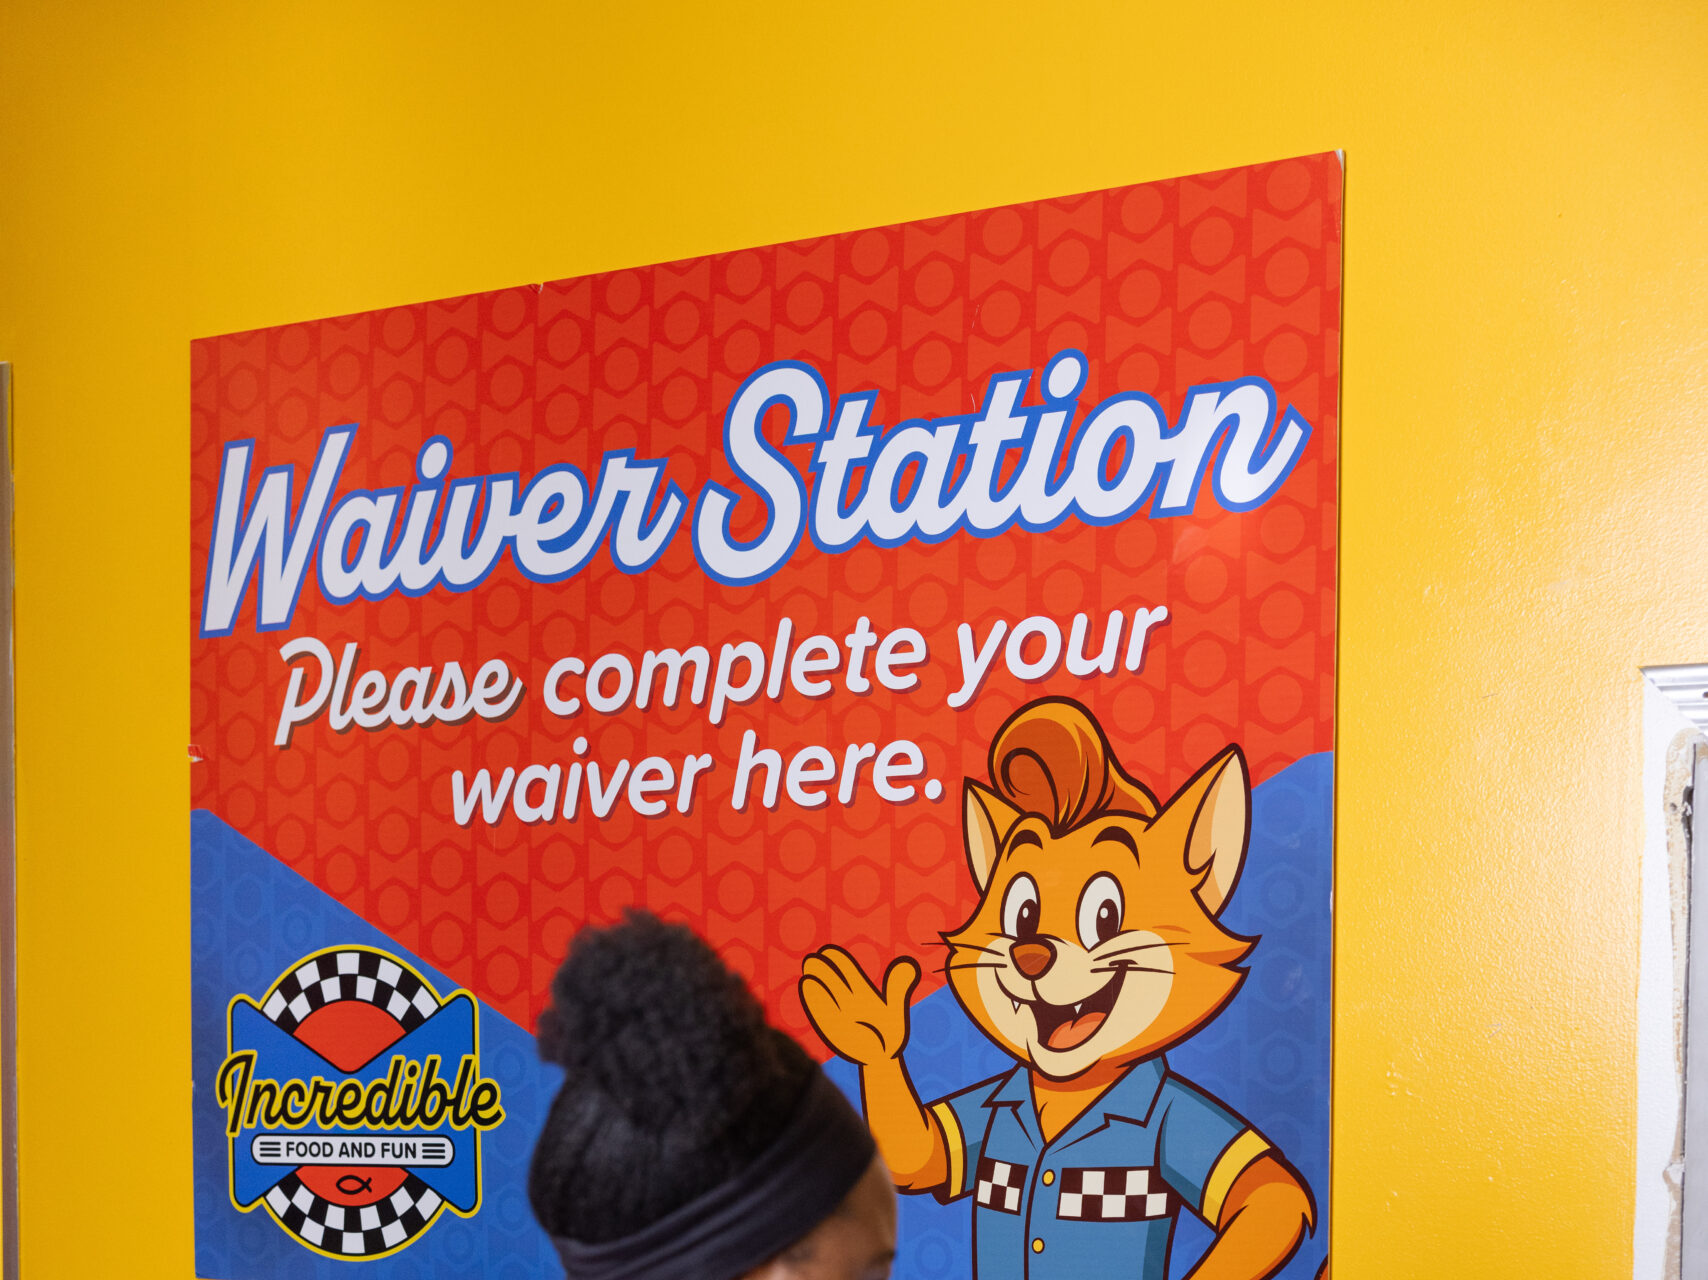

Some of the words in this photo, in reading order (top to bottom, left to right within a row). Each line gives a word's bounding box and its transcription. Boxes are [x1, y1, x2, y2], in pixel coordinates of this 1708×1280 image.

[199, 423, 687, 638] Waiver
[692, 350, 1312, 588] Station
[274, 636, 523, 746] Please
[543, 617, 928, 724] complete
[947, 606, 1168, 708] your
[451, 738, 712, 826] waiver
[731, 731, 944, 812] here.
[215, 1050, 505, 1136] Incredible
[286, 1141, 334, 1158] FOOD
[338, 1142, 376, 1158] AND
[381, 1142, 417, 1159] FUN
